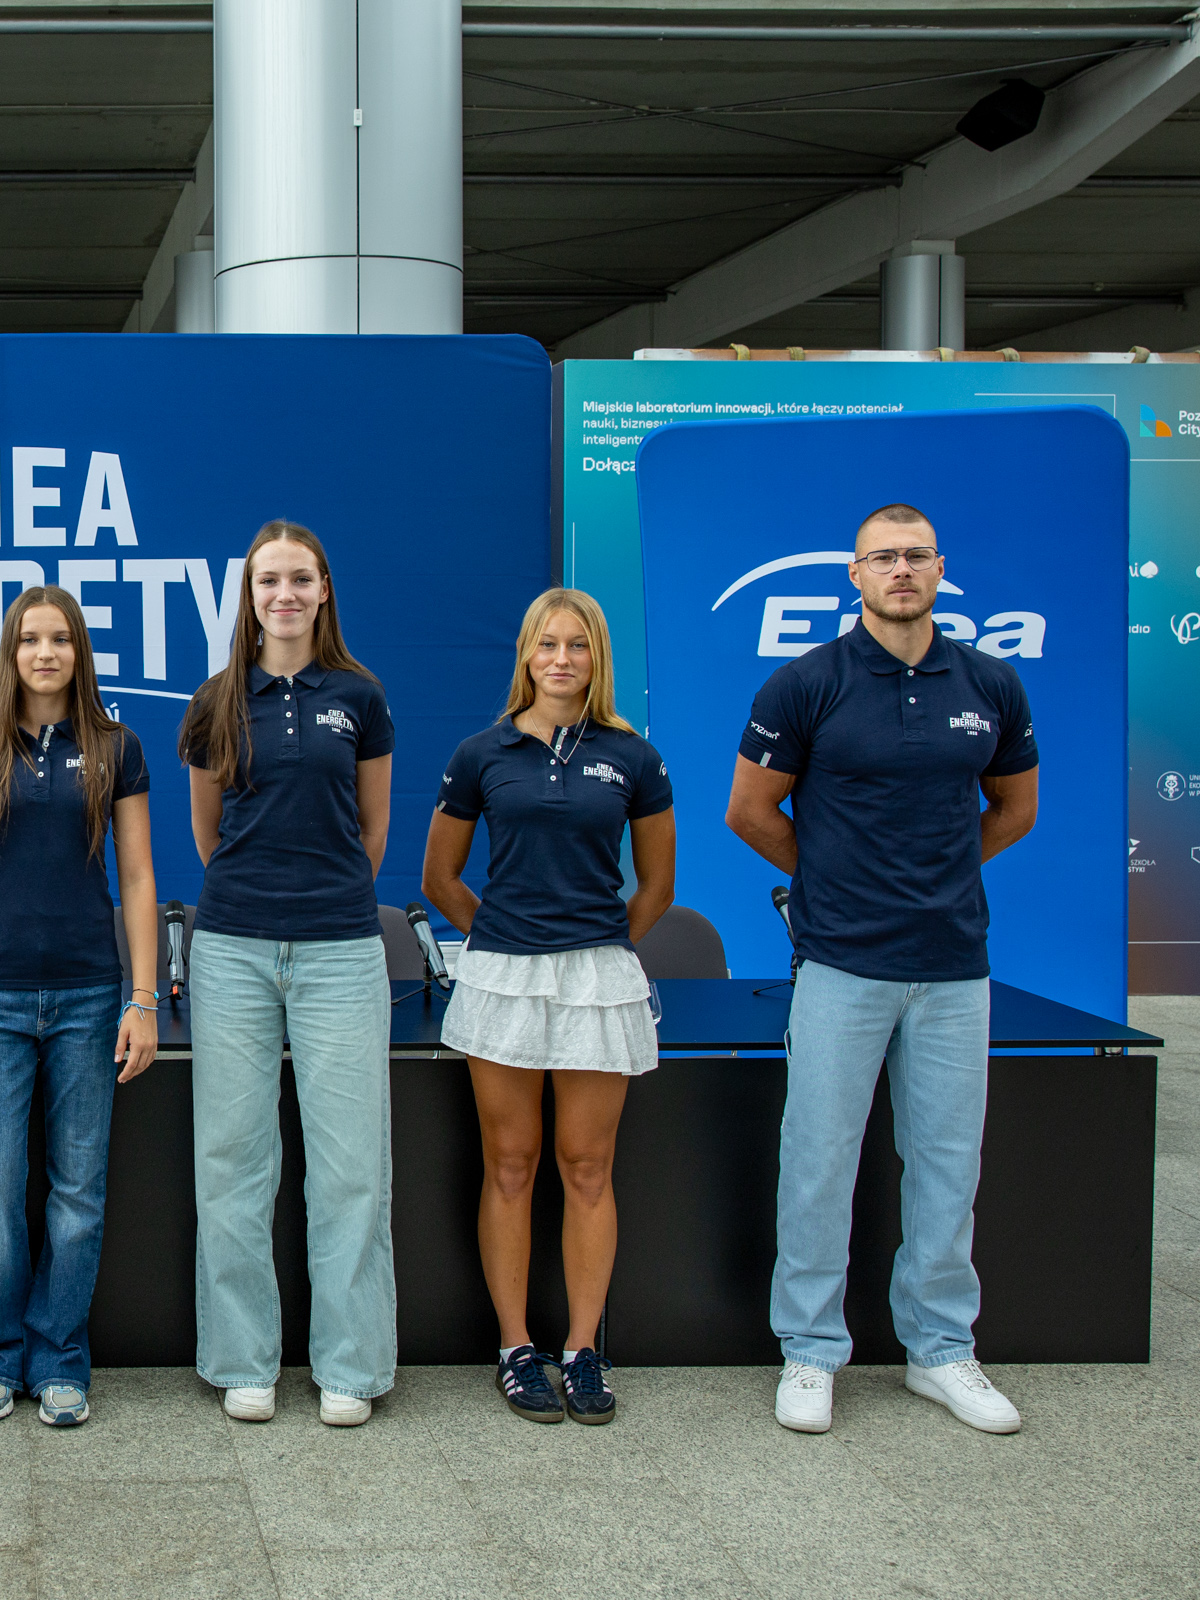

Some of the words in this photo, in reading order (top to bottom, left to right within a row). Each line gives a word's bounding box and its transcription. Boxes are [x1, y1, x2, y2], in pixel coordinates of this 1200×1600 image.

[583, 401, 633, 415] Miejskie
[636, 401, 712, 413] laboratorium
[715, 402, 775, 416] innowacji,
[777, 402, 809, 414] które
[811, 402, 844, 415] łączy
[583, 418, 618, 430] nauki,
[328, 709, 345, 718] ENEA
[961, 712, 980, 720] ENEA
[949, 717, 991, 731] ENERGETYK
[596, 763, 613, 773] ENEA
[583, 766, 624, 784] ENERGETYK
